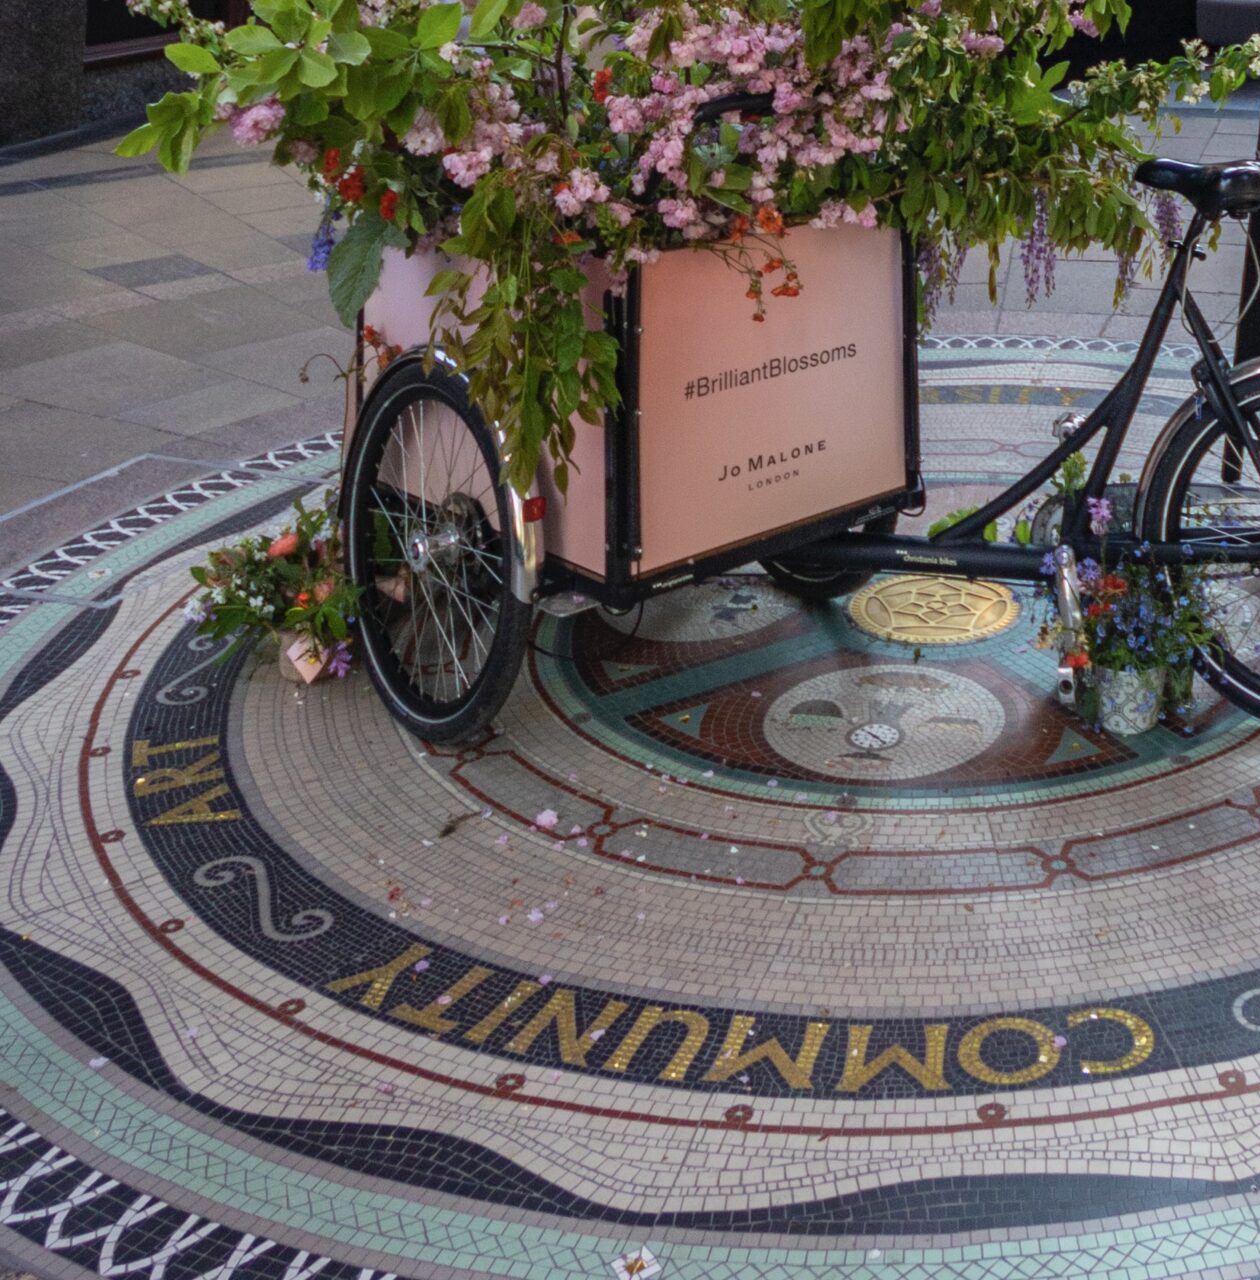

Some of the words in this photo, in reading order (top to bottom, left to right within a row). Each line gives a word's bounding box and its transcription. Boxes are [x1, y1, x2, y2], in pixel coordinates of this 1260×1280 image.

[684, 342, 858, 401] #BrilliantBlossoms
[748, 469, 801, 492] LONDON
[131, 734, 242, 828] ART
[326, 941, 1155, 1095] COMMUNITY
